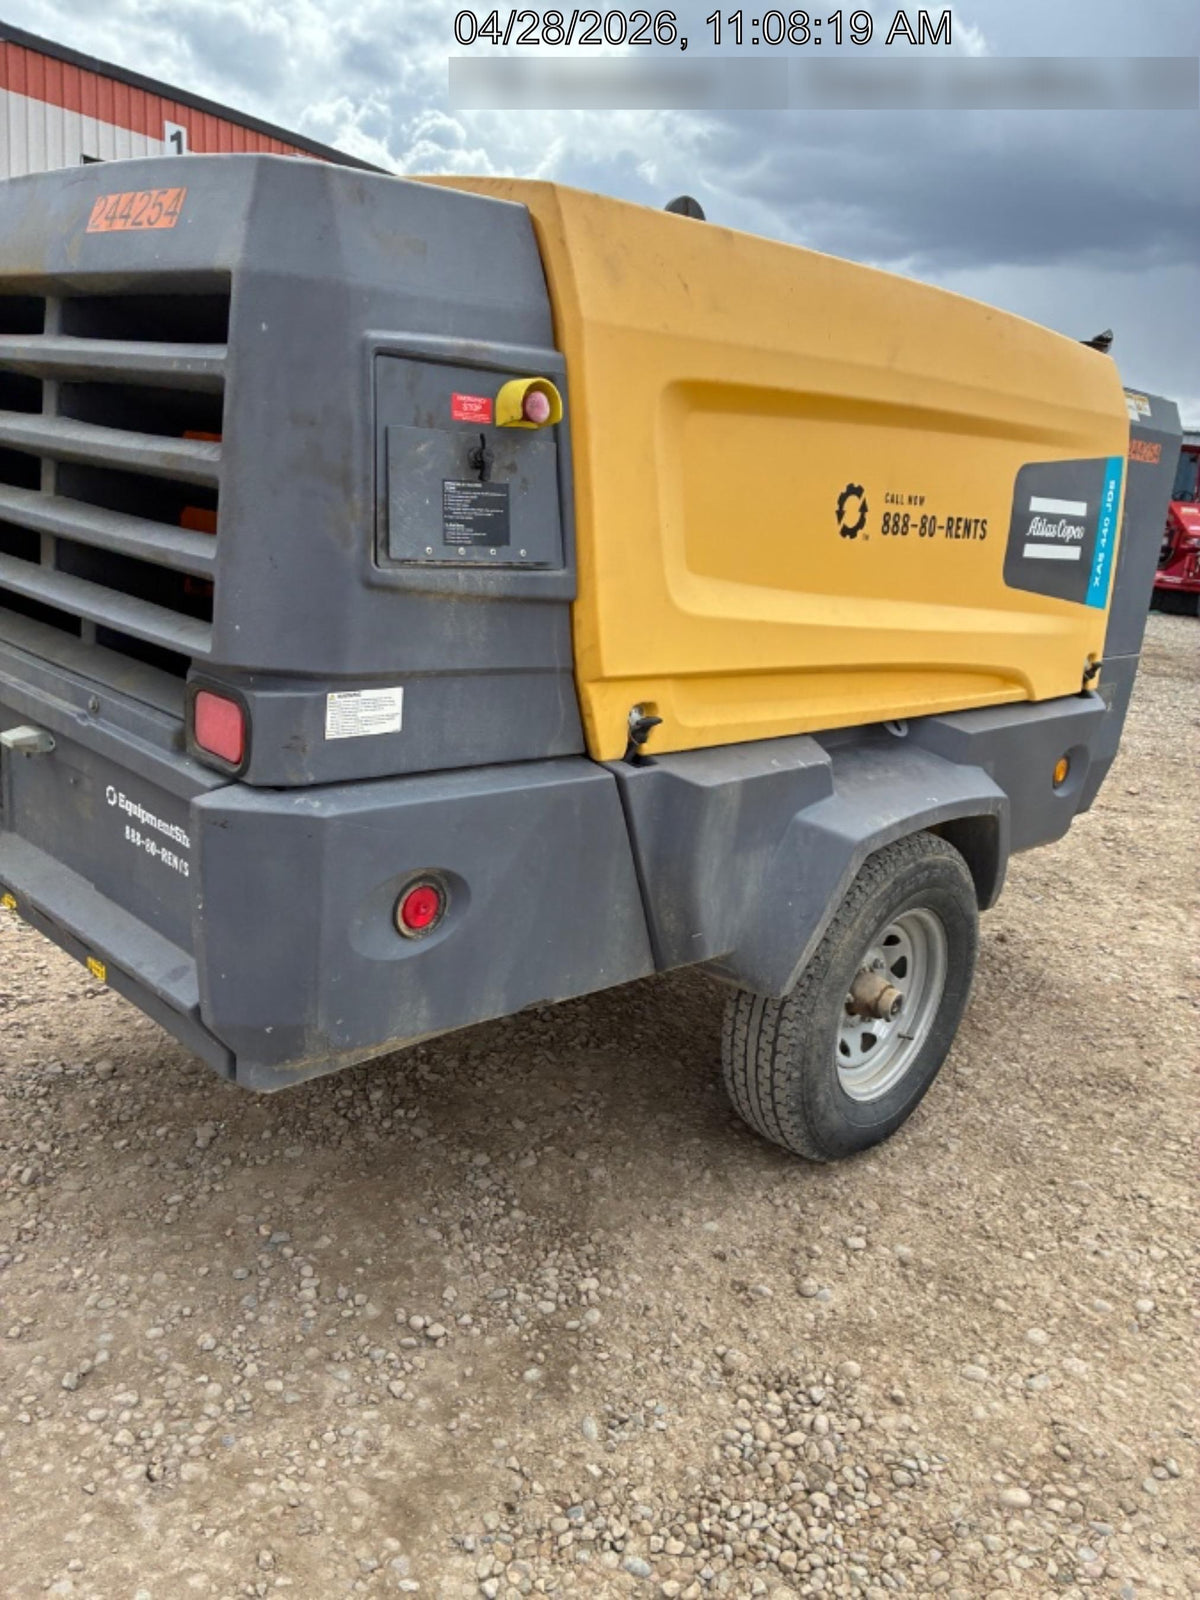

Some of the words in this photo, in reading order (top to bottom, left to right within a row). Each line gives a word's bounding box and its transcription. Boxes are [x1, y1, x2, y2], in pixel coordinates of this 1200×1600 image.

[170, 130, 183, 155] 1
[91, 188, 182, 228] 244254
[885, 492, 905, 506] CALL
[908, 495, 926, 507] NOW
[881, 511, 988, 541] 888-80-RENTS
[1026, 516, 1057, 538] Atlas
[1058, 518, 1086, 543] Copco
[1101, 517, 1110, 548] 440
